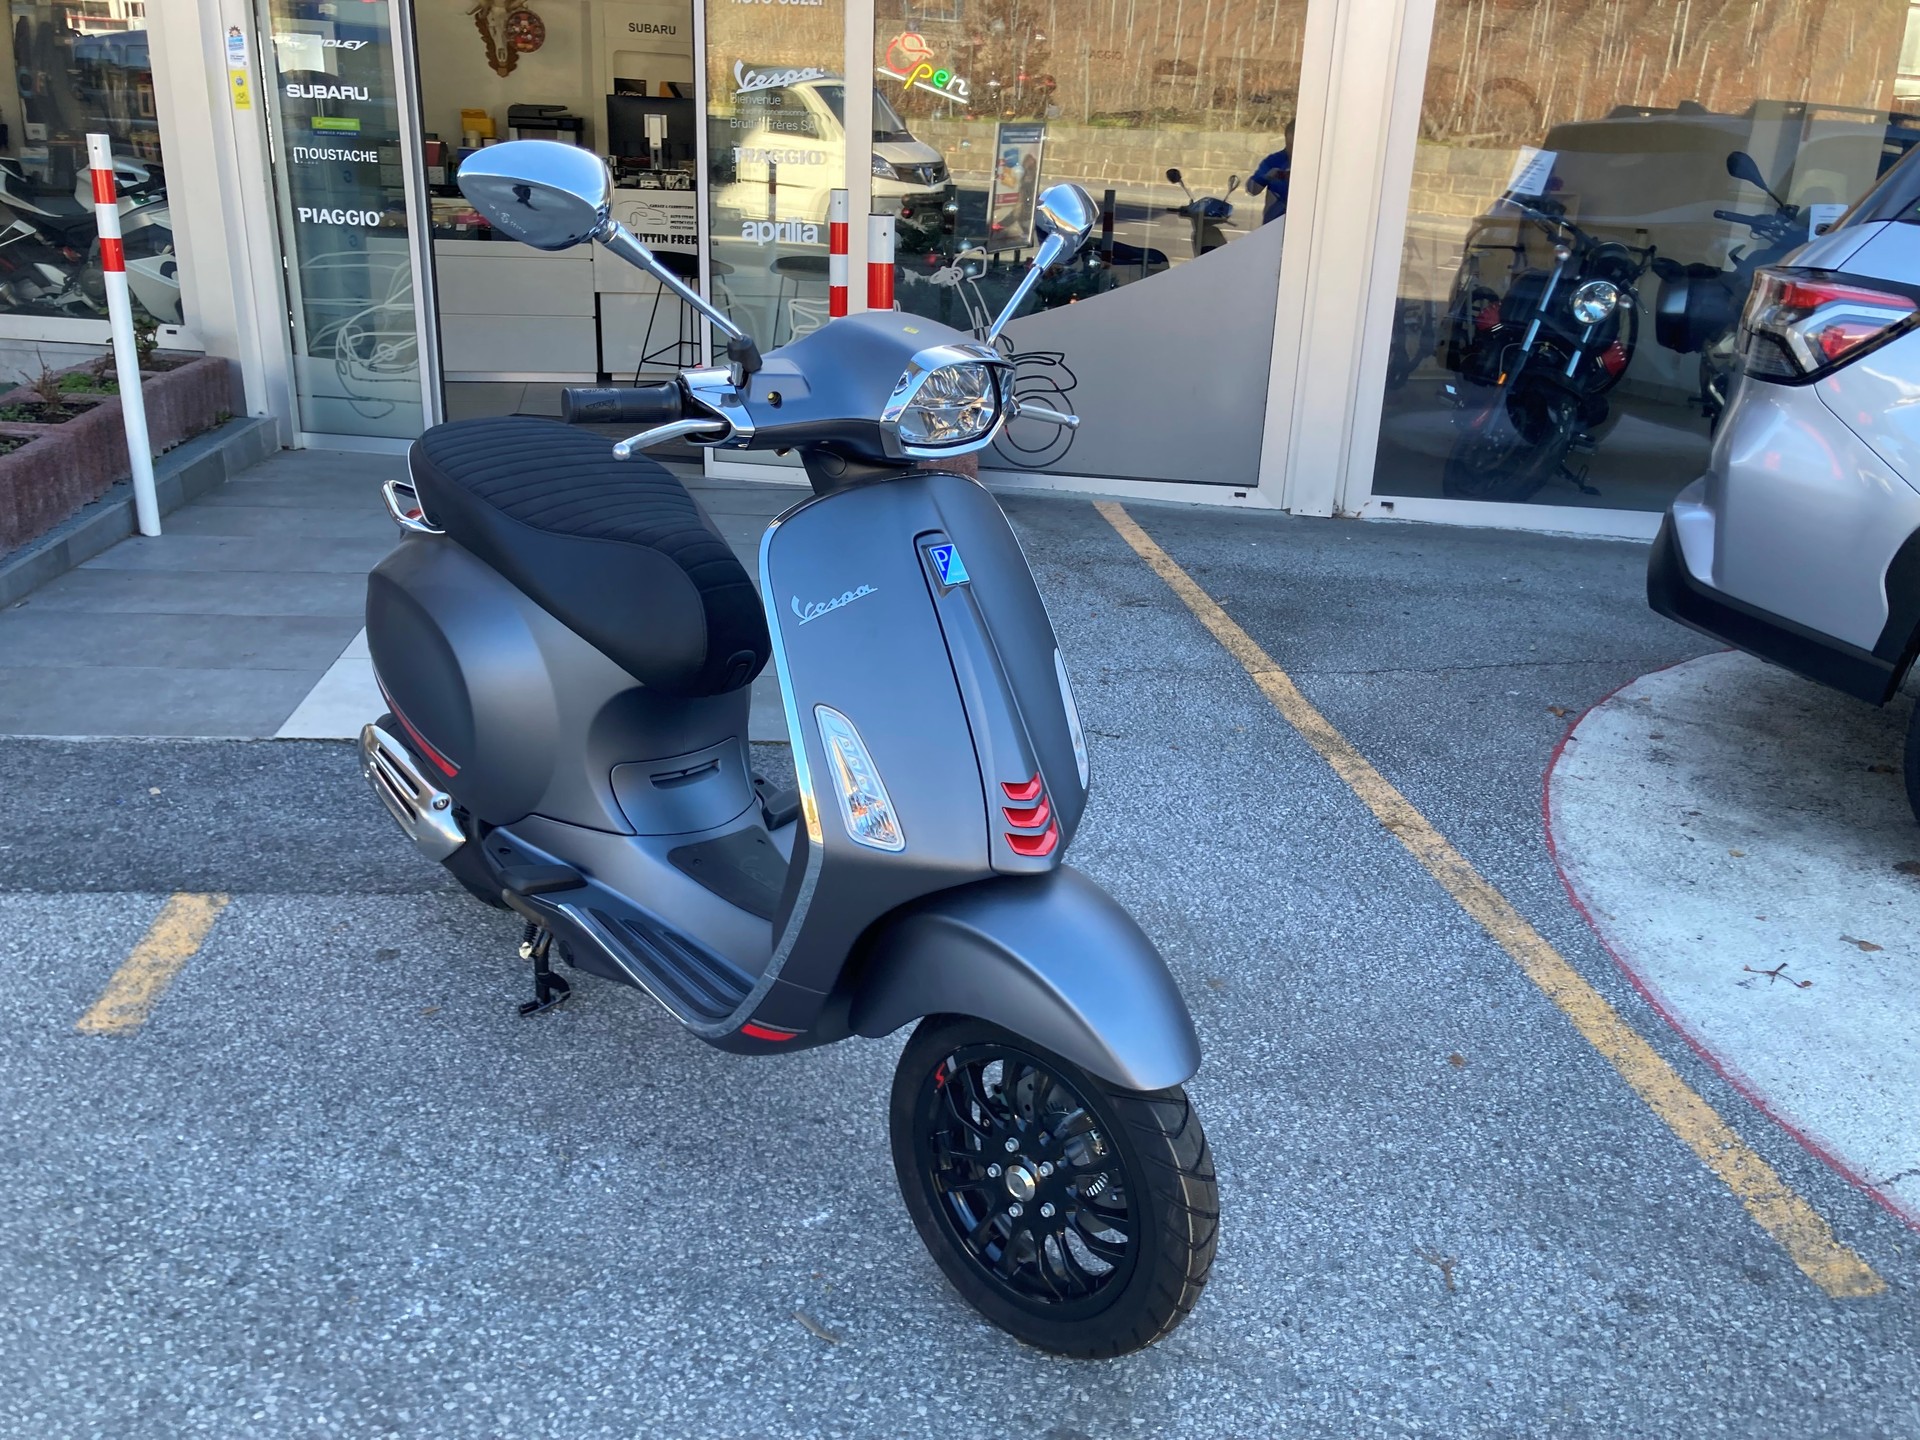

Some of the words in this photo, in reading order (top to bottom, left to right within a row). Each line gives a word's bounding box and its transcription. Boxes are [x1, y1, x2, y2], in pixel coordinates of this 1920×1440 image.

[628, 22, 676, 35] SUBARU
[886, 33, 970, 96] Open
[734, 59, 824, 94] Vespa
[286, 84, 369, 101] SUBARU
[730, 93, 781, 105] Bienvenue
[294, 146, 379, 164] MOUSTACHE
[298, 207, 381, 227] PIAGGIO
[632, 232, 668, 244] UTTIN
[671, 234, 697, 246] FRER
[742, 217, 818, 246] aprilia
[791, 584, 878, 626] Vespa
